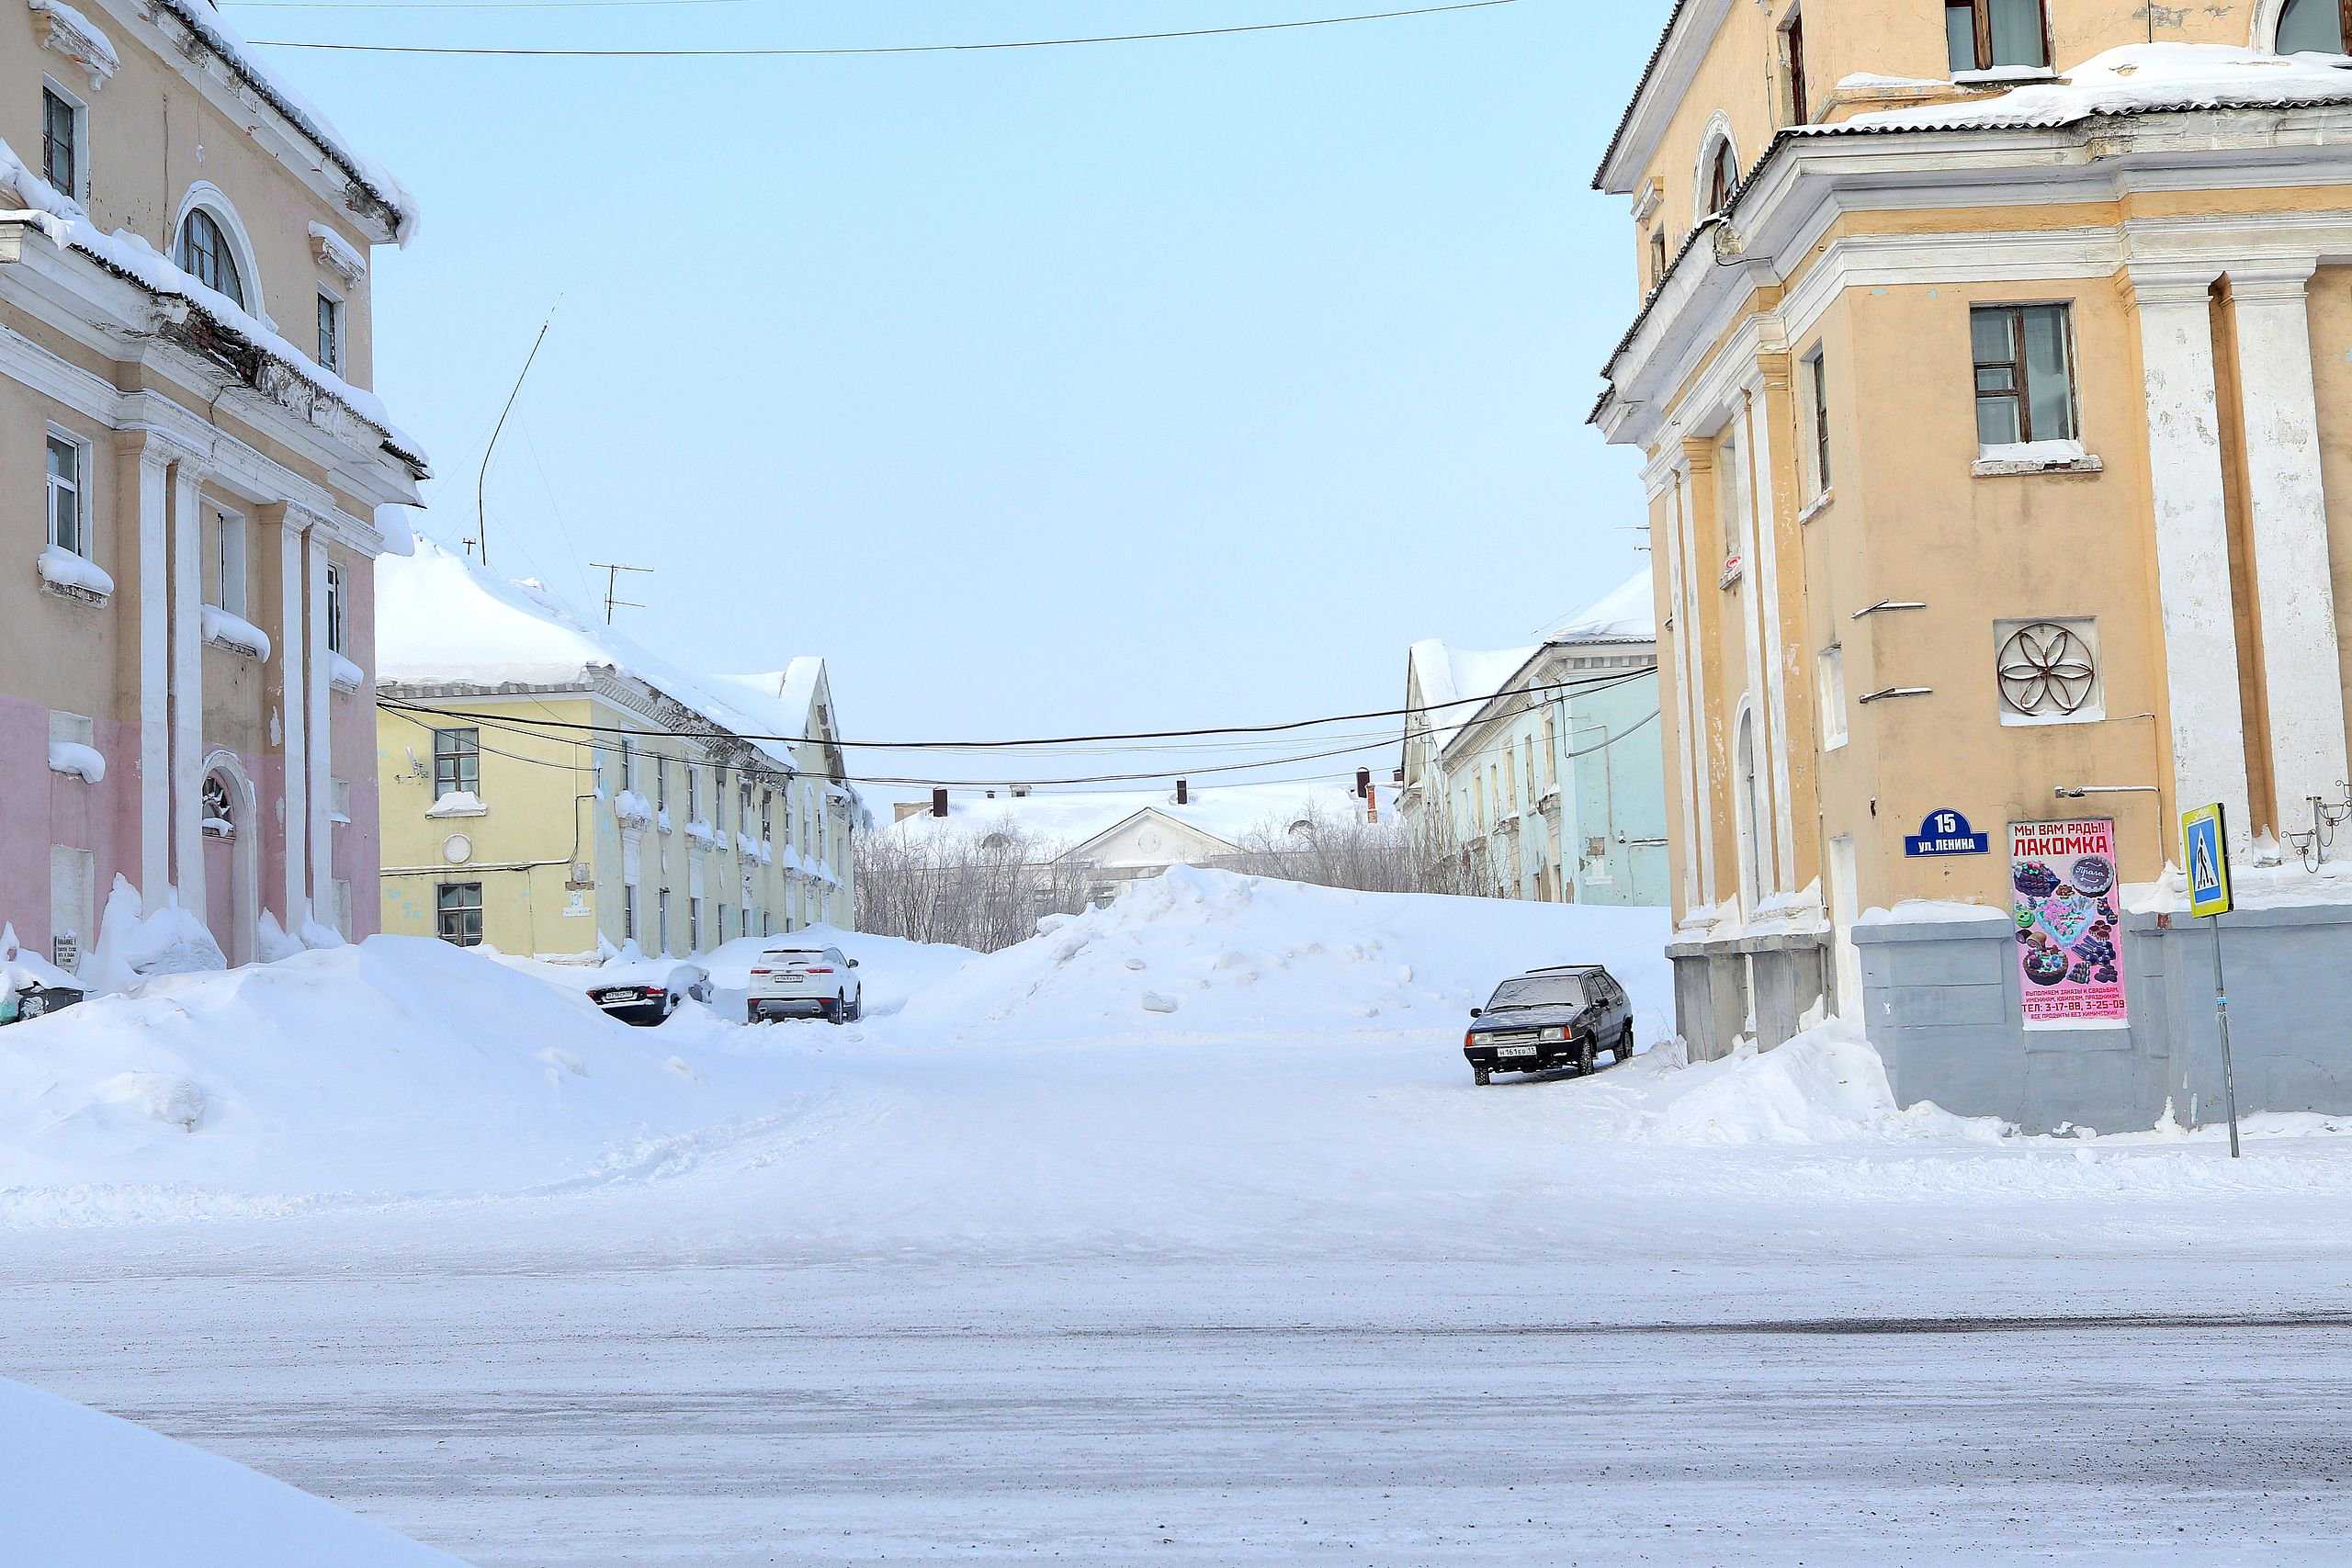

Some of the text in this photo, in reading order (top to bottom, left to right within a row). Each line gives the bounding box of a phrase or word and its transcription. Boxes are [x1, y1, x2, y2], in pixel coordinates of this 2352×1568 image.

[1934, 813, 1956, 833] 15
[2014, 822, 2105, 836] МЫ ВАМ РАДЫ!
[1936, 838, 1975, 852] ЛЕНИНА
[2014, 836, 2109, 856] ЛАКОМКА
[2075, 866, 2105, 877] Прага
[2021, 999, 2124, 1012] ТЕЛ: 3-17-88, 3-25-09
